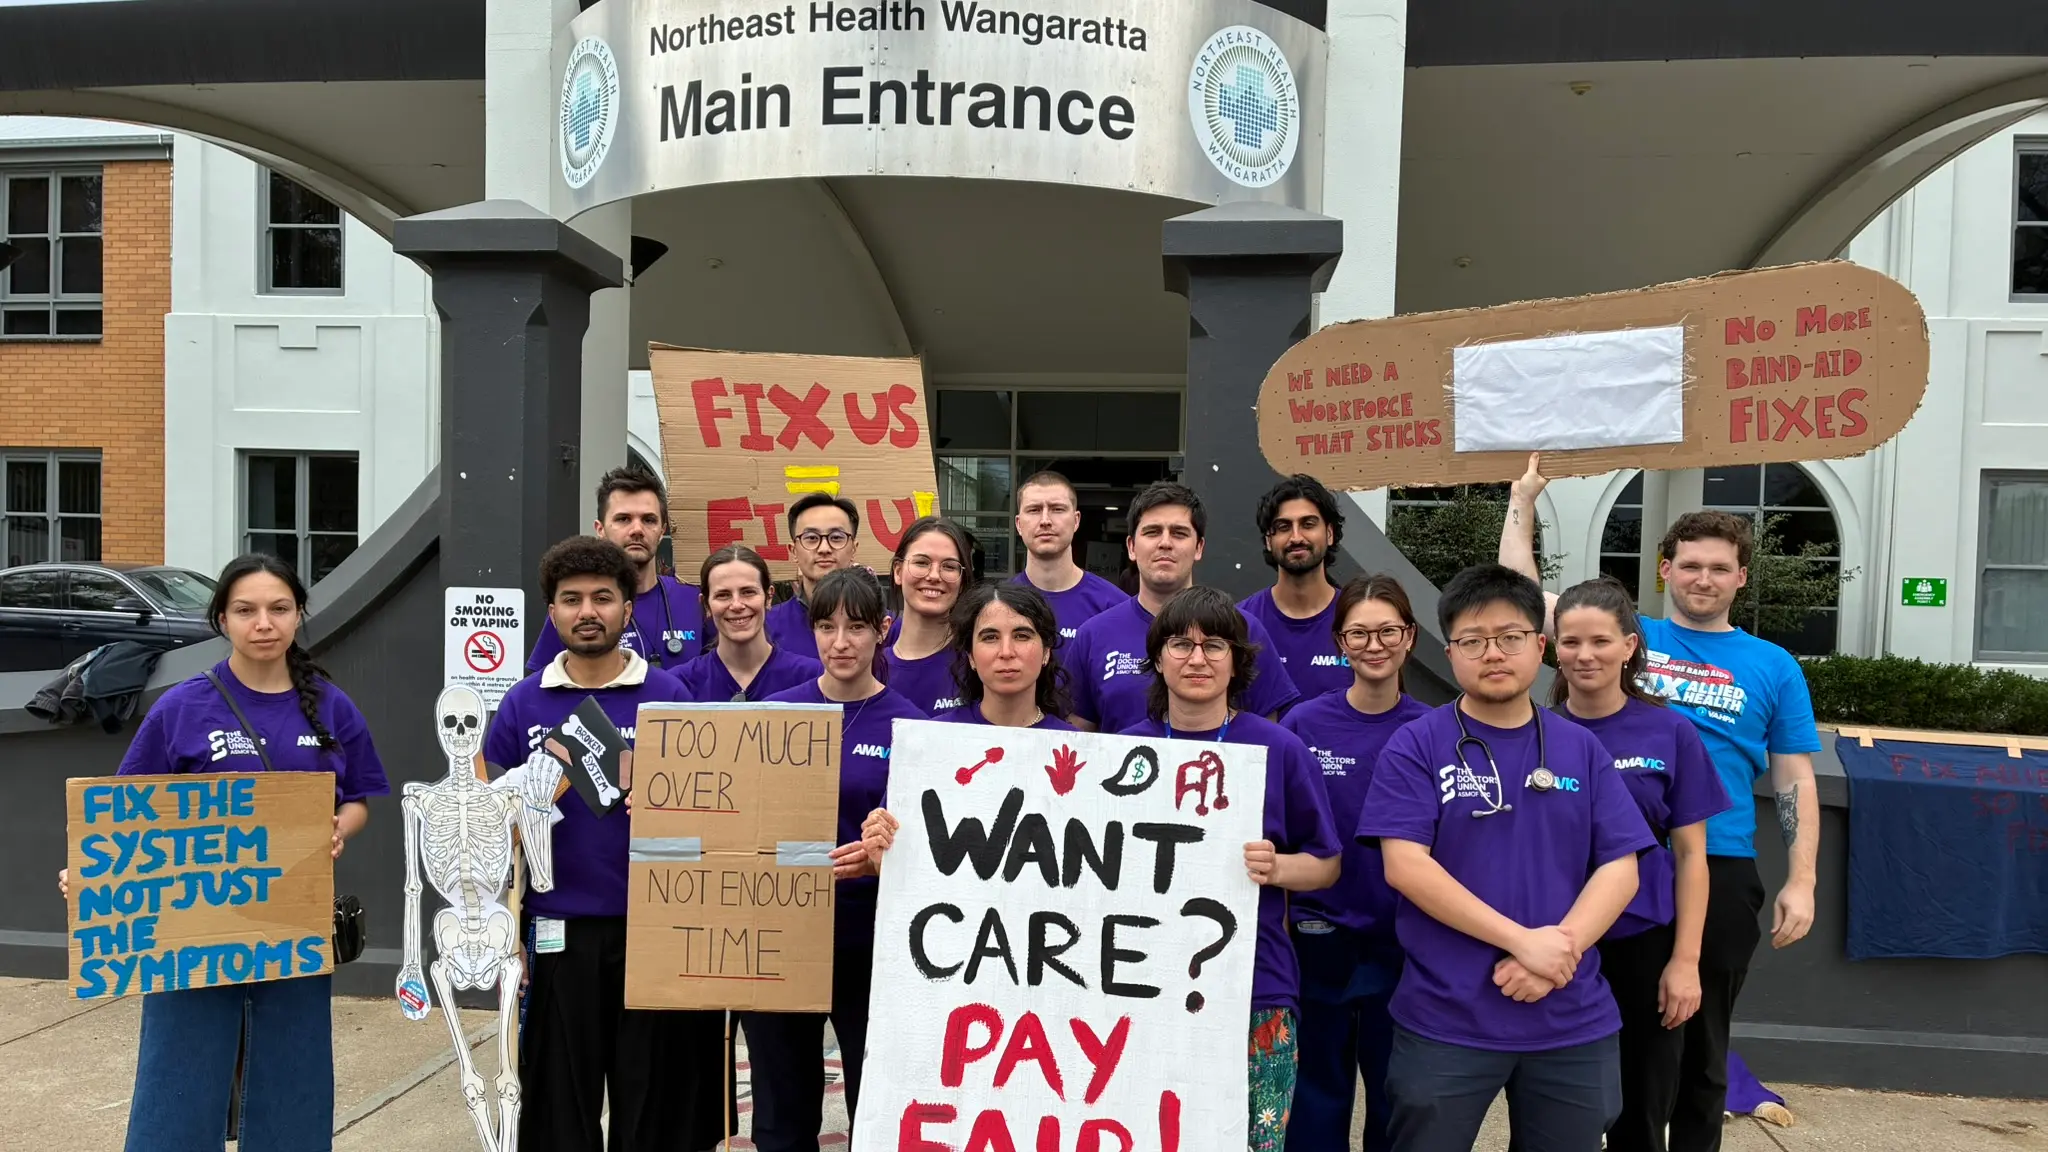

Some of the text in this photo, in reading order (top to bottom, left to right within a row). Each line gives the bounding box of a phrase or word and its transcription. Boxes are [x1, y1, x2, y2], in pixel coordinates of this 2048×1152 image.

[650, 0, 1147, 56] Northeast Health Wangaratta
[594, 40, 617, 95] HEALTH
[1193, 31, 1297, 118] NORTHEAST HEALTH
[660, 66, 1135, 142] Main Entrance
[1208, 142, 1286, 182] WANGARATTA
[1724, 305, 1872, 345] NO MORE
[1287, 361, 1398, 392] WE NEED A
[1726, 348, 1862, 390] BAND-AID
[691, 377, 919, 451] FIX US
[1288, 392, 1413, 423] WORKFORCE
[1729, 388, 1868, 443] FIXES
[1295, 419, 1442, 456] THAT STICKS
[707, 496, 790, 561] FI
[455, 606, 514, 616] SMOKING
[475, 594, 494, 604] NO
[450, 617, 519, 628] OR VAPING
[1647, 660, 1730, 679] NO MORE BAND AIDS
[1686, 681, 1745, 700] ALLIED
[1683, 691, 1743, 712] HEALTH
[225, 730, 242, 738] THE
[575, 725, 603, 754] BROKEN
[648, 718, 830, 767] TOO MUCH
[584, 755, 609, 793] SYSTEM
[648, 771, 734, 810] OVER
[1456, 768, 1473, 776] THE
[83, 778, 256, 825] FIX THE
[80, 824, 268, 878] SYSTEM
[921, 785, 1206, 894] WANT
[78, 867, 283, 922] NOT JUST
[648, 868, 832, 907] NOT ENOUGH
[73, 915, 159, 960] THE
[672, 926, 782, 976] TIME
[908, 897, 1237, 1014] CARE?
[76, 936, 327, 1000] SYMPTOMS
[940, 1002, 1133, 1105] PAY
